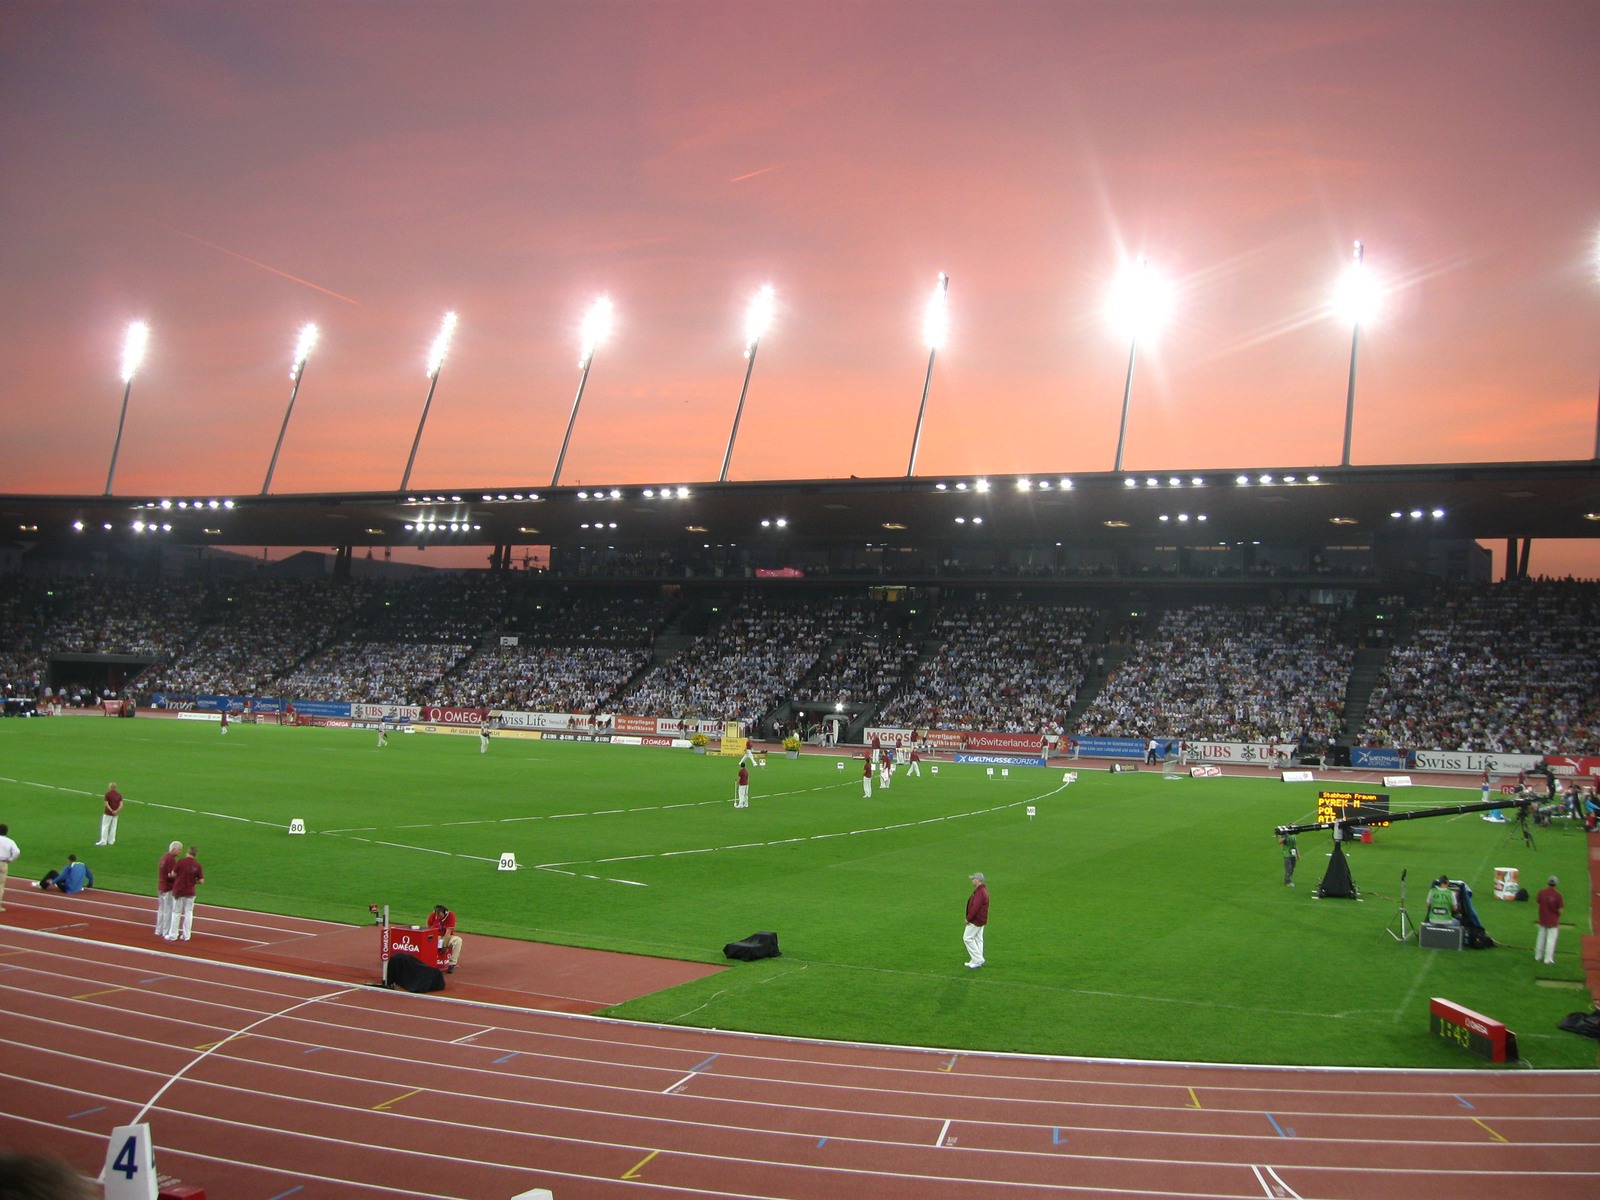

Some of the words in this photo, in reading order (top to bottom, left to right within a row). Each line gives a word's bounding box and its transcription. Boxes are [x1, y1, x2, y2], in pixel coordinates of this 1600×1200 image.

[365, 706, 383, 716] UBS
[502, 713, 523, 725] wiss
[526, 714, 547, 727] Life
[648, 738, 671, 746] OMEGA
[968, 736, 1042, 749] MySwitzerland.co
[1203, 745, 1231, 758] UBS
[1416, 753, 1461, 769] Swiss
[1467, 755, 1499, 771] Life
[1318, 798, 1348, 807] PYREK
[1353, 800, 1360, 808] M
[1318, 807, 1336, 815] POL
[290, 823, 303, 832] 80
[500, 859, 514, 868] 90
[392, 942, 420, 953] OMEGA
[112, 1135, 138, 1180] 4
